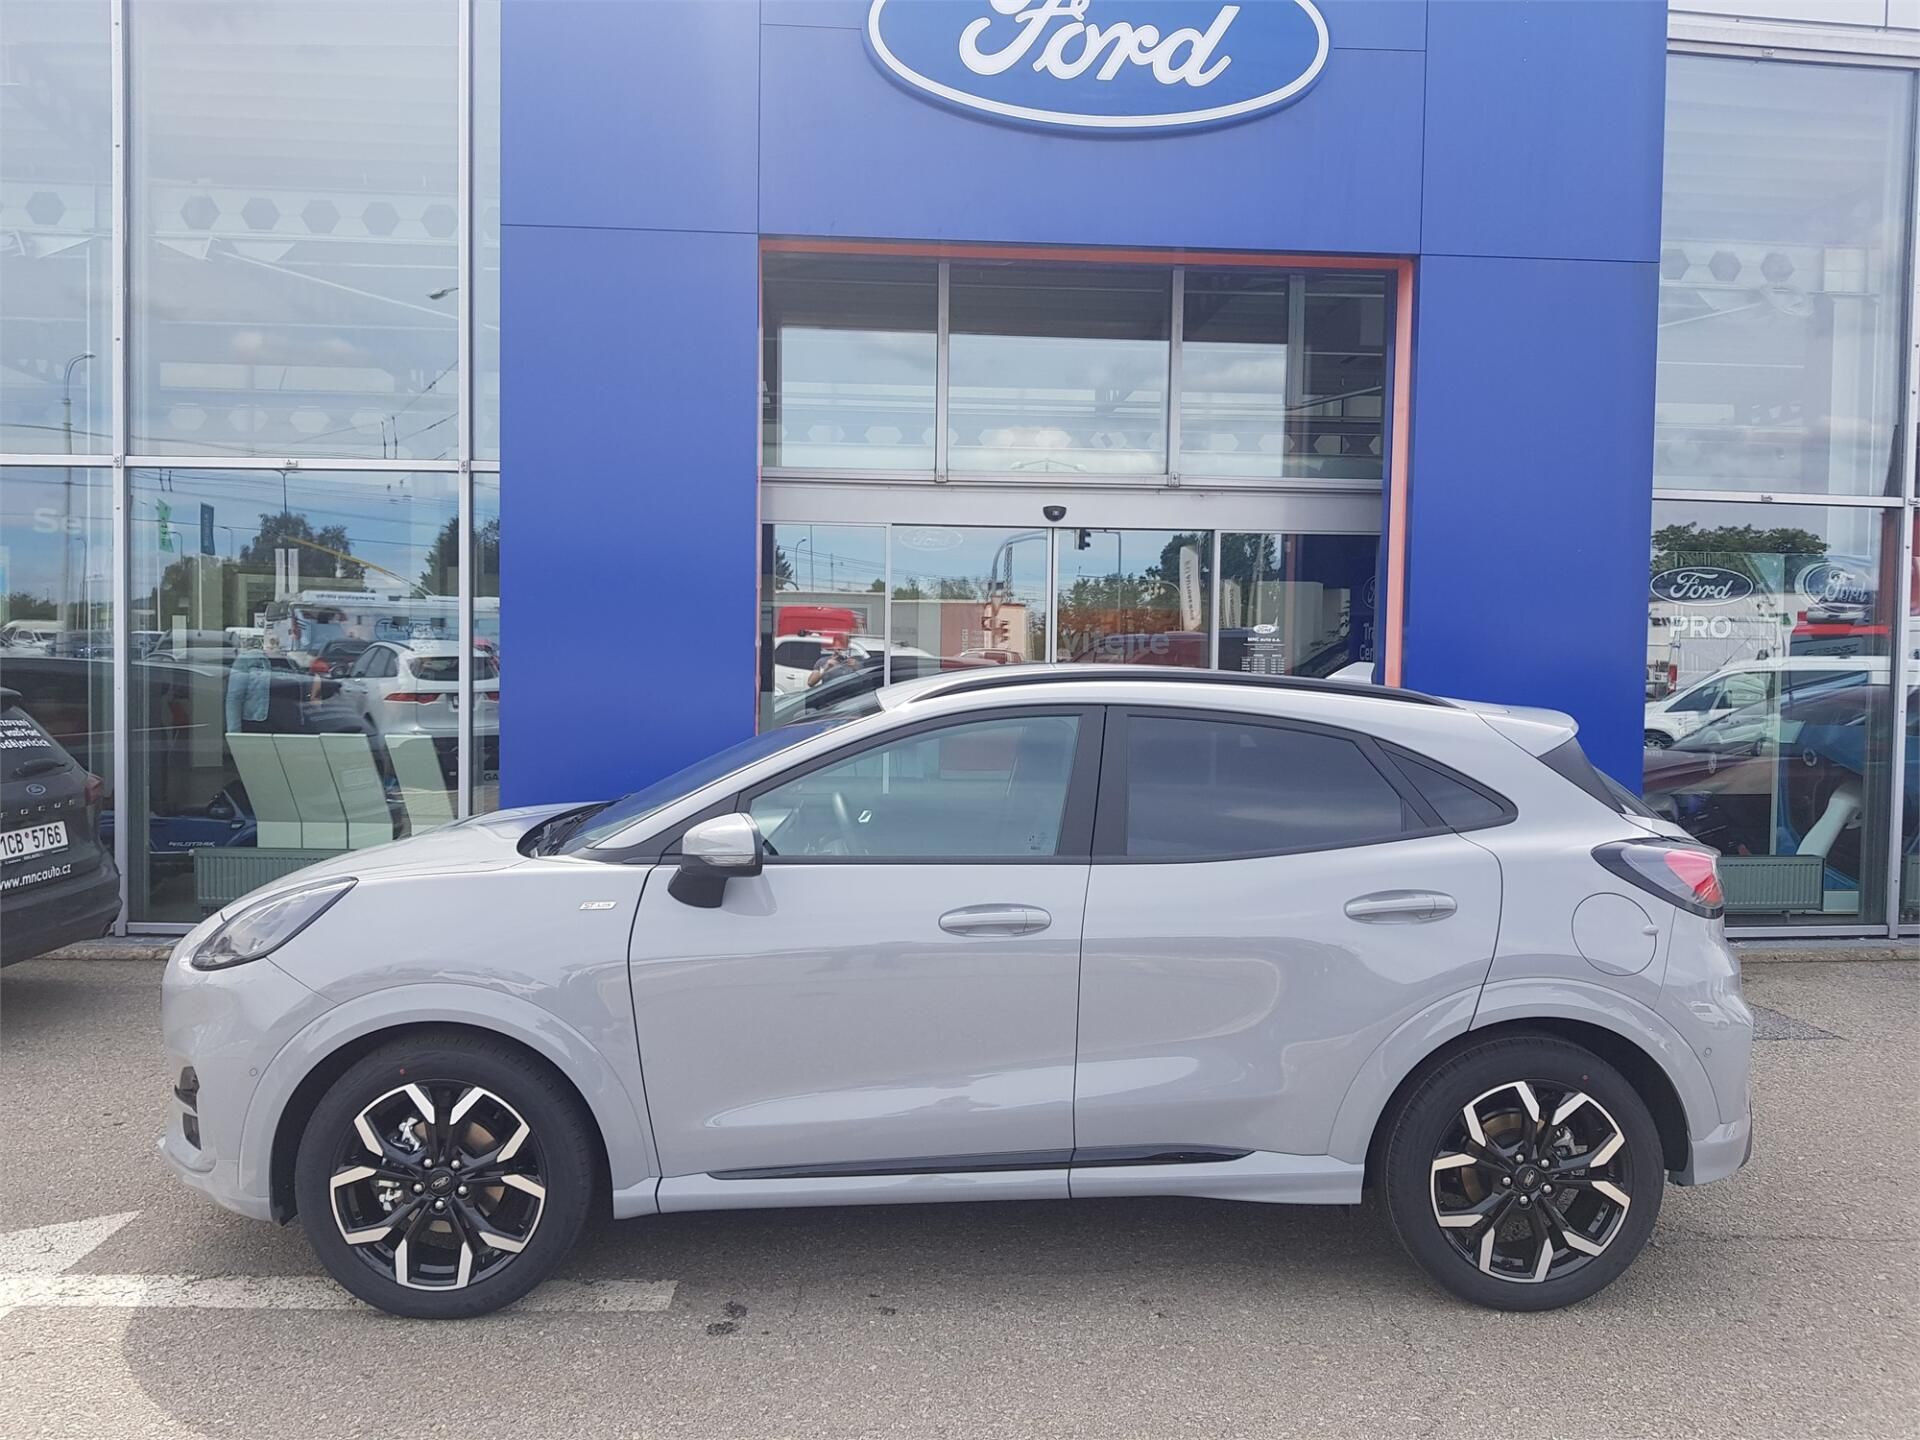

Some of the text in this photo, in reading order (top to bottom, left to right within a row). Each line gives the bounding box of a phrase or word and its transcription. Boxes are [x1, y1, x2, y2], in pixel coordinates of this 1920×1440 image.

[959, 0, 1241, 87] Ford
[1669, 571, 1734, 599] Ford
[1669, 615, 1732, 638] PRO
[31, 825, 62, 849] 5766
